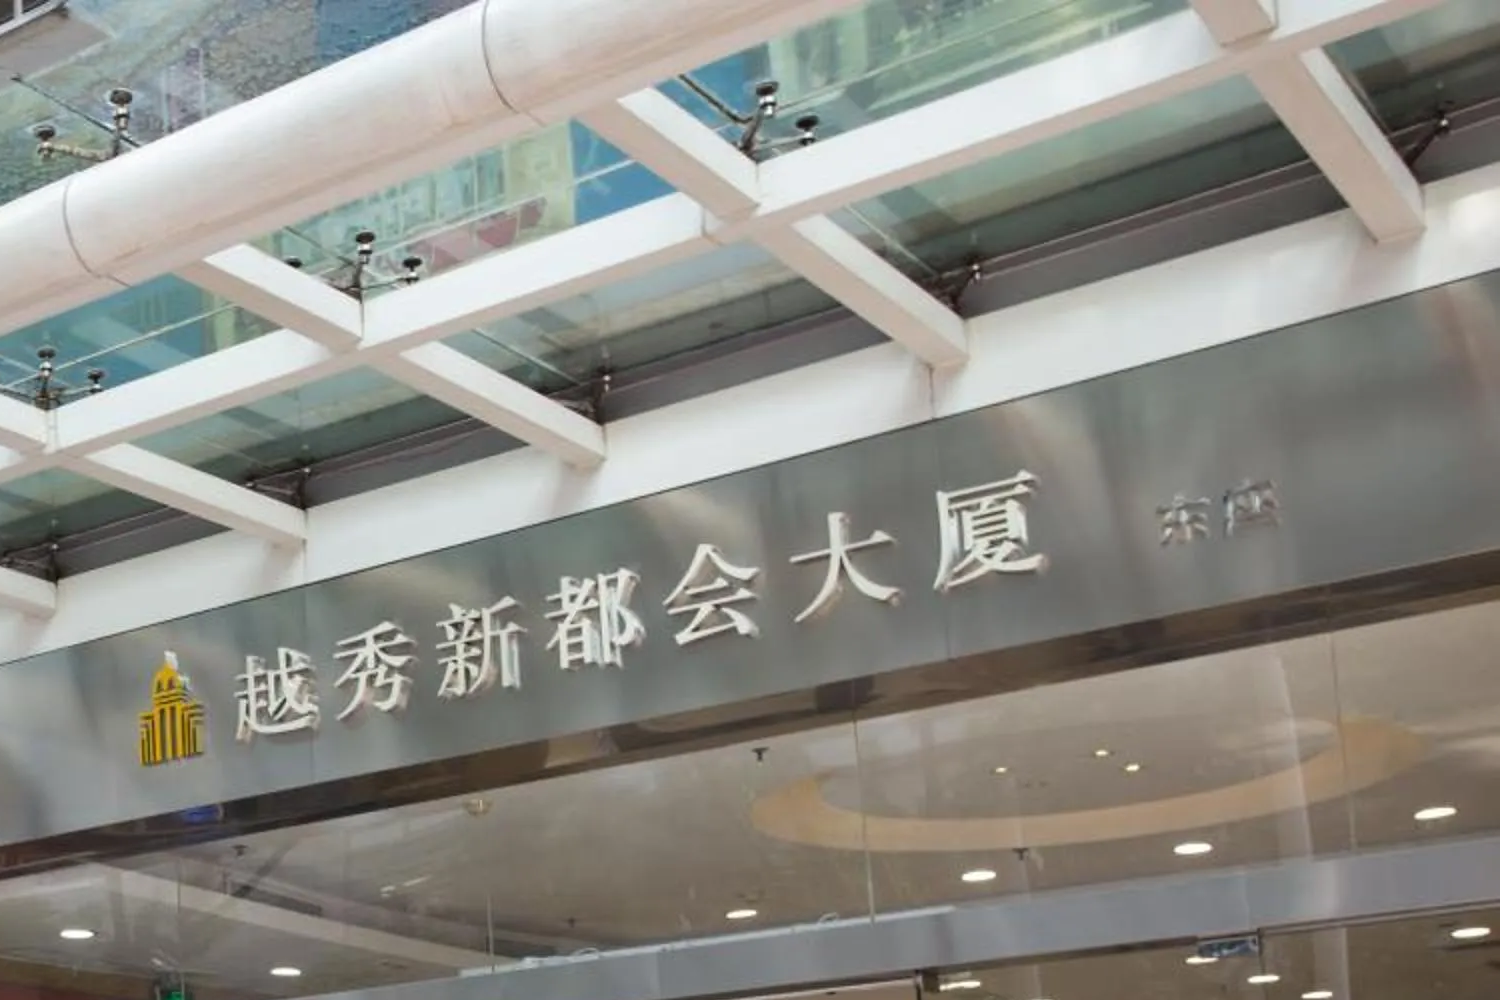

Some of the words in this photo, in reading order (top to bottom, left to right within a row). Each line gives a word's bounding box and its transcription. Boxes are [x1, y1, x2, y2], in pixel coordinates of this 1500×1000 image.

[234, 472, 1048, 742] 越秀新都会大厦
